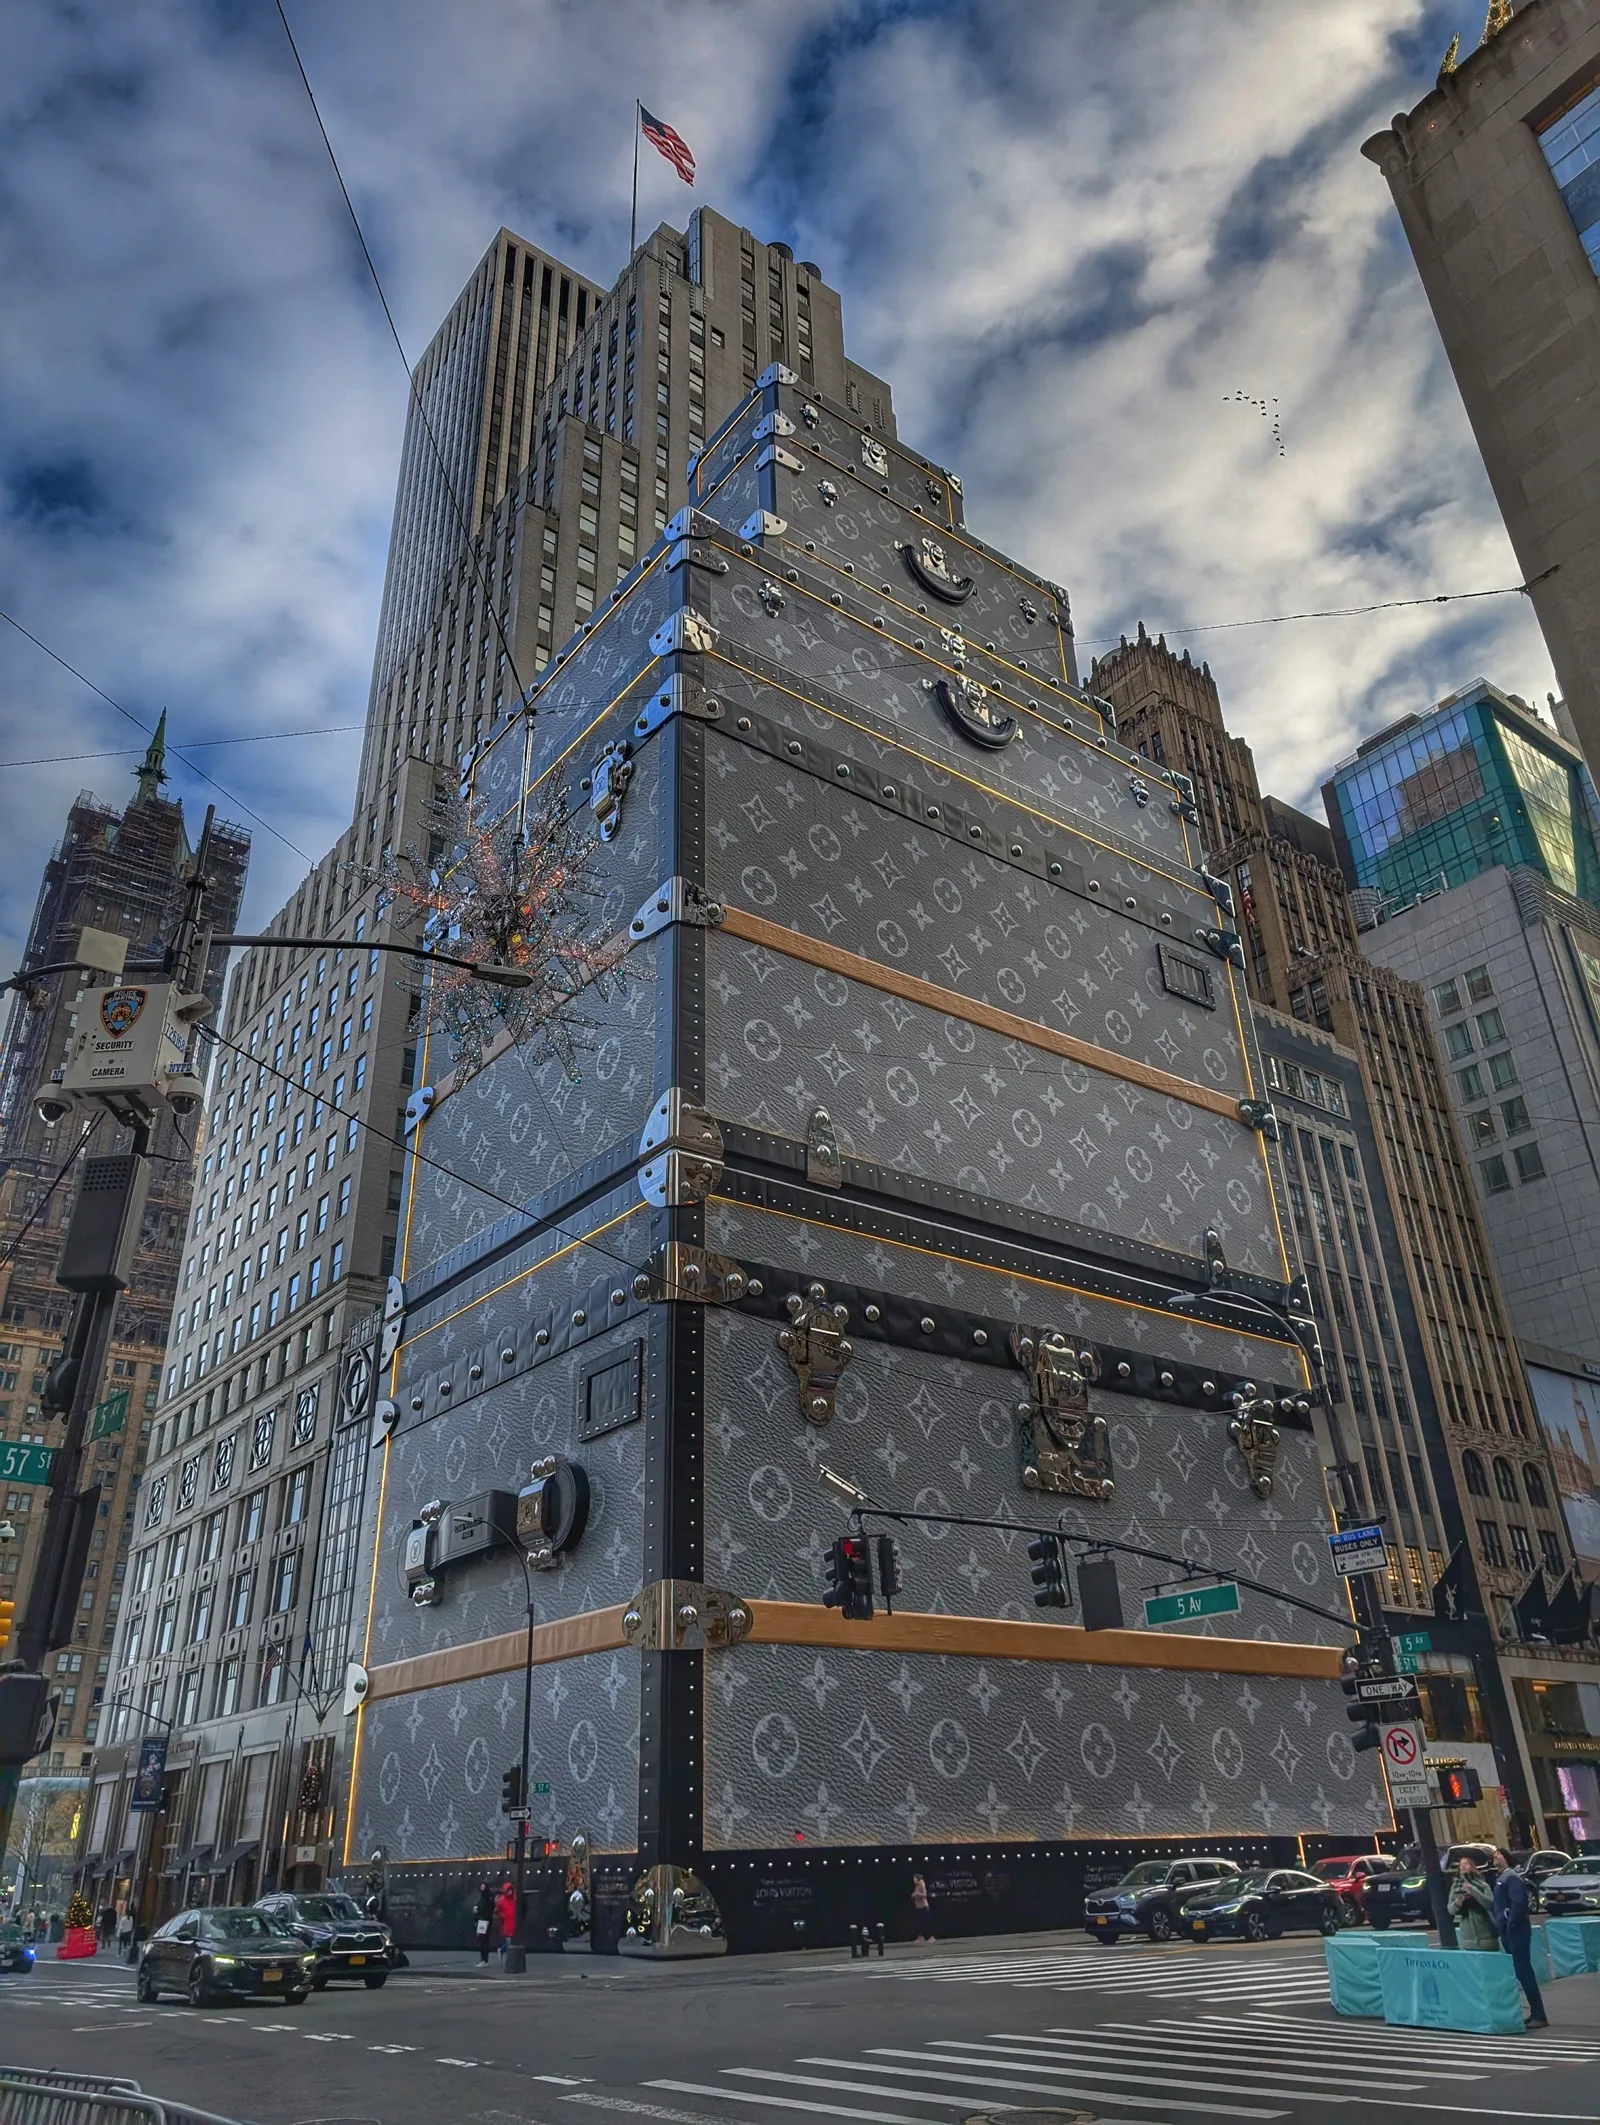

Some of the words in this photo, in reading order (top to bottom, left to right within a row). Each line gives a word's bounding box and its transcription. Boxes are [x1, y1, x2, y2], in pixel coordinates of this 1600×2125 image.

[95, 1040, 134, 1050] SECURITY
[91, 1067, 125, 1077] CAMERA
[169, 1063, 193, 1073] NYPD
[98, 1406, 108, 1433] 5
[3, 1447, 31, 1476] 57
[37, 1451, 52, 1469] St
[1343, 1533, 1357, 1541] BUS
[1358, 1529, 1376, 1539] LANE
[1334, 1542, 1358, 1553] BUSES
[1360, 1538, 1378, 1548] ONLY
[1177, 1598, 1185, 1615] 5
[1189, 1596, 1202, 1613] Av
[1406, 1637, 1413, 1651] 5
[1366, 1685, 1384, 1696] ONE
[1390, 1682, 1408, 1693] WAY
[1399, 1785, 1420, 1794] EXCEPT
[779, 1886, 812, 1898] VUITTON
